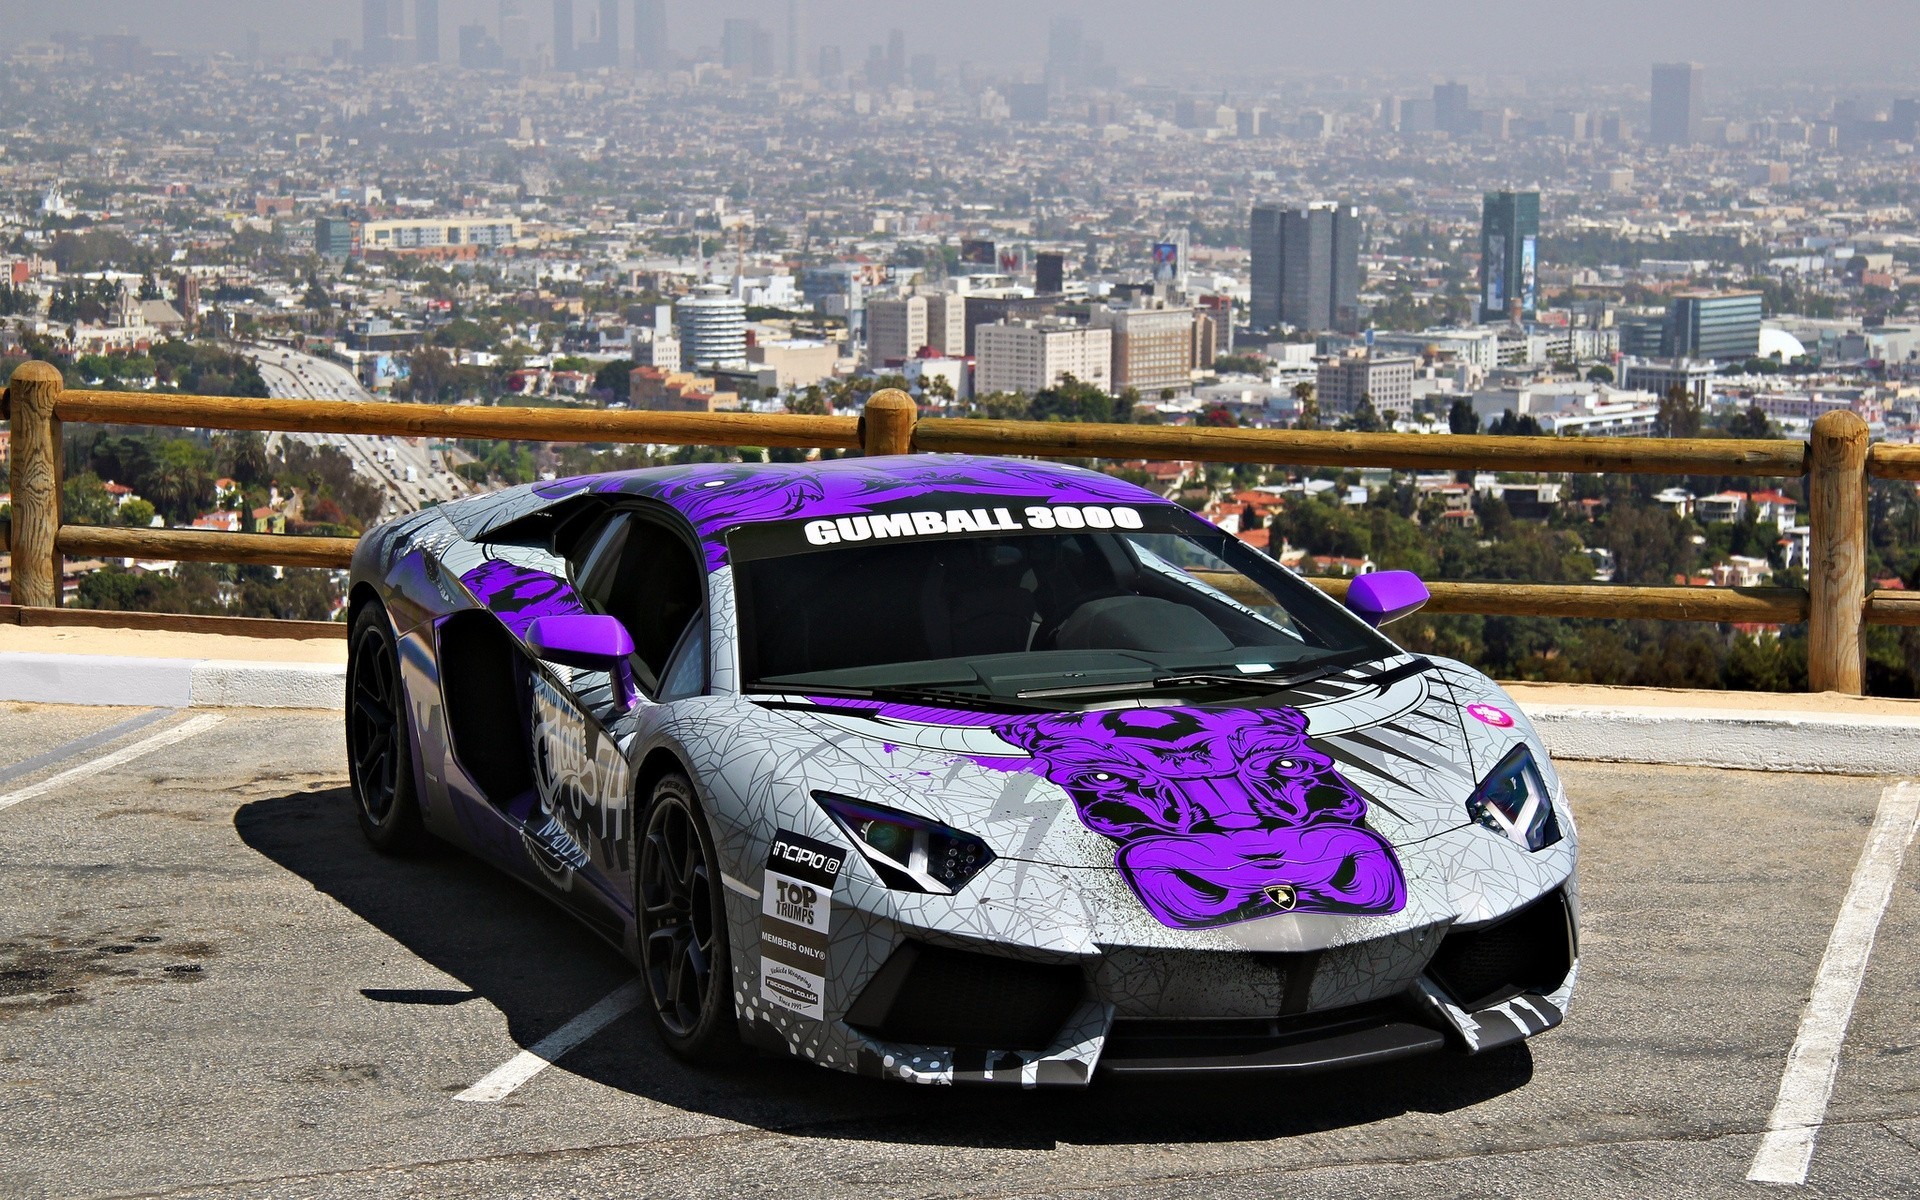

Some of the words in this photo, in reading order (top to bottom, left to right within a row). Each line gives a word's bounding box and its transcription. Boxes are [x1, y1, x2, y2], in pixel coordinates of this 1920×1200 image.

[803, 507, 1023, 546] GUMBALL
[1024, 505, 1144, 530] 3000
[776, 880, 817, 908] TOP
[776, 900, 815, 925] TRUMPS
[761, 931, 797, 951] MEMBERS
[766, 979, 817, 1002] raccoon.co.uk
